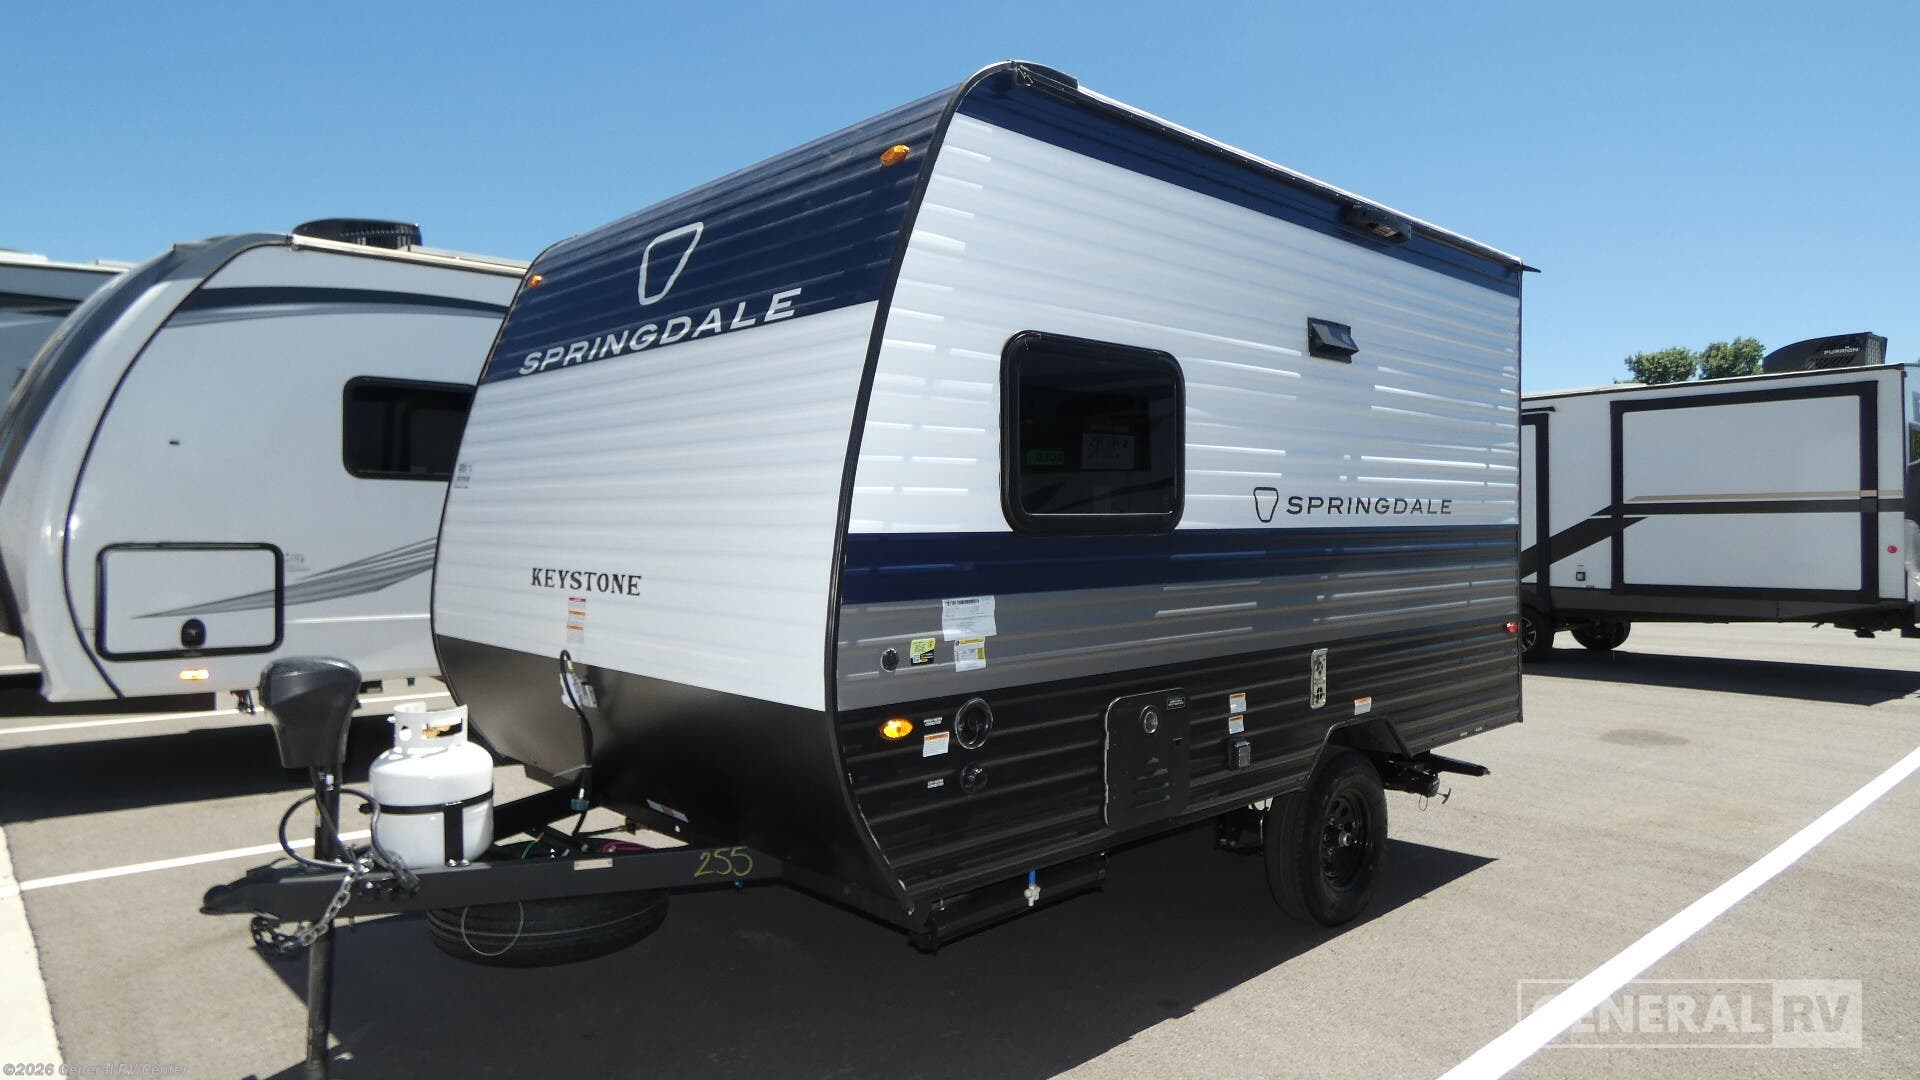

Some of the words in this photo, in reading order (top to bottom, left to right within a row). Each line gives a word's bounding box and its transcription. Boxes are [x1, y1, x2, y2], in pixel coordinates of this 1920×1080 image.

[518, 288, 802, 376] SPRINGDALE
[1286, 496, 1453, 515] SPRINGDALE
[531, 567, 642, 597] KEYSTONE
[694, 846, 753, 878] 255
